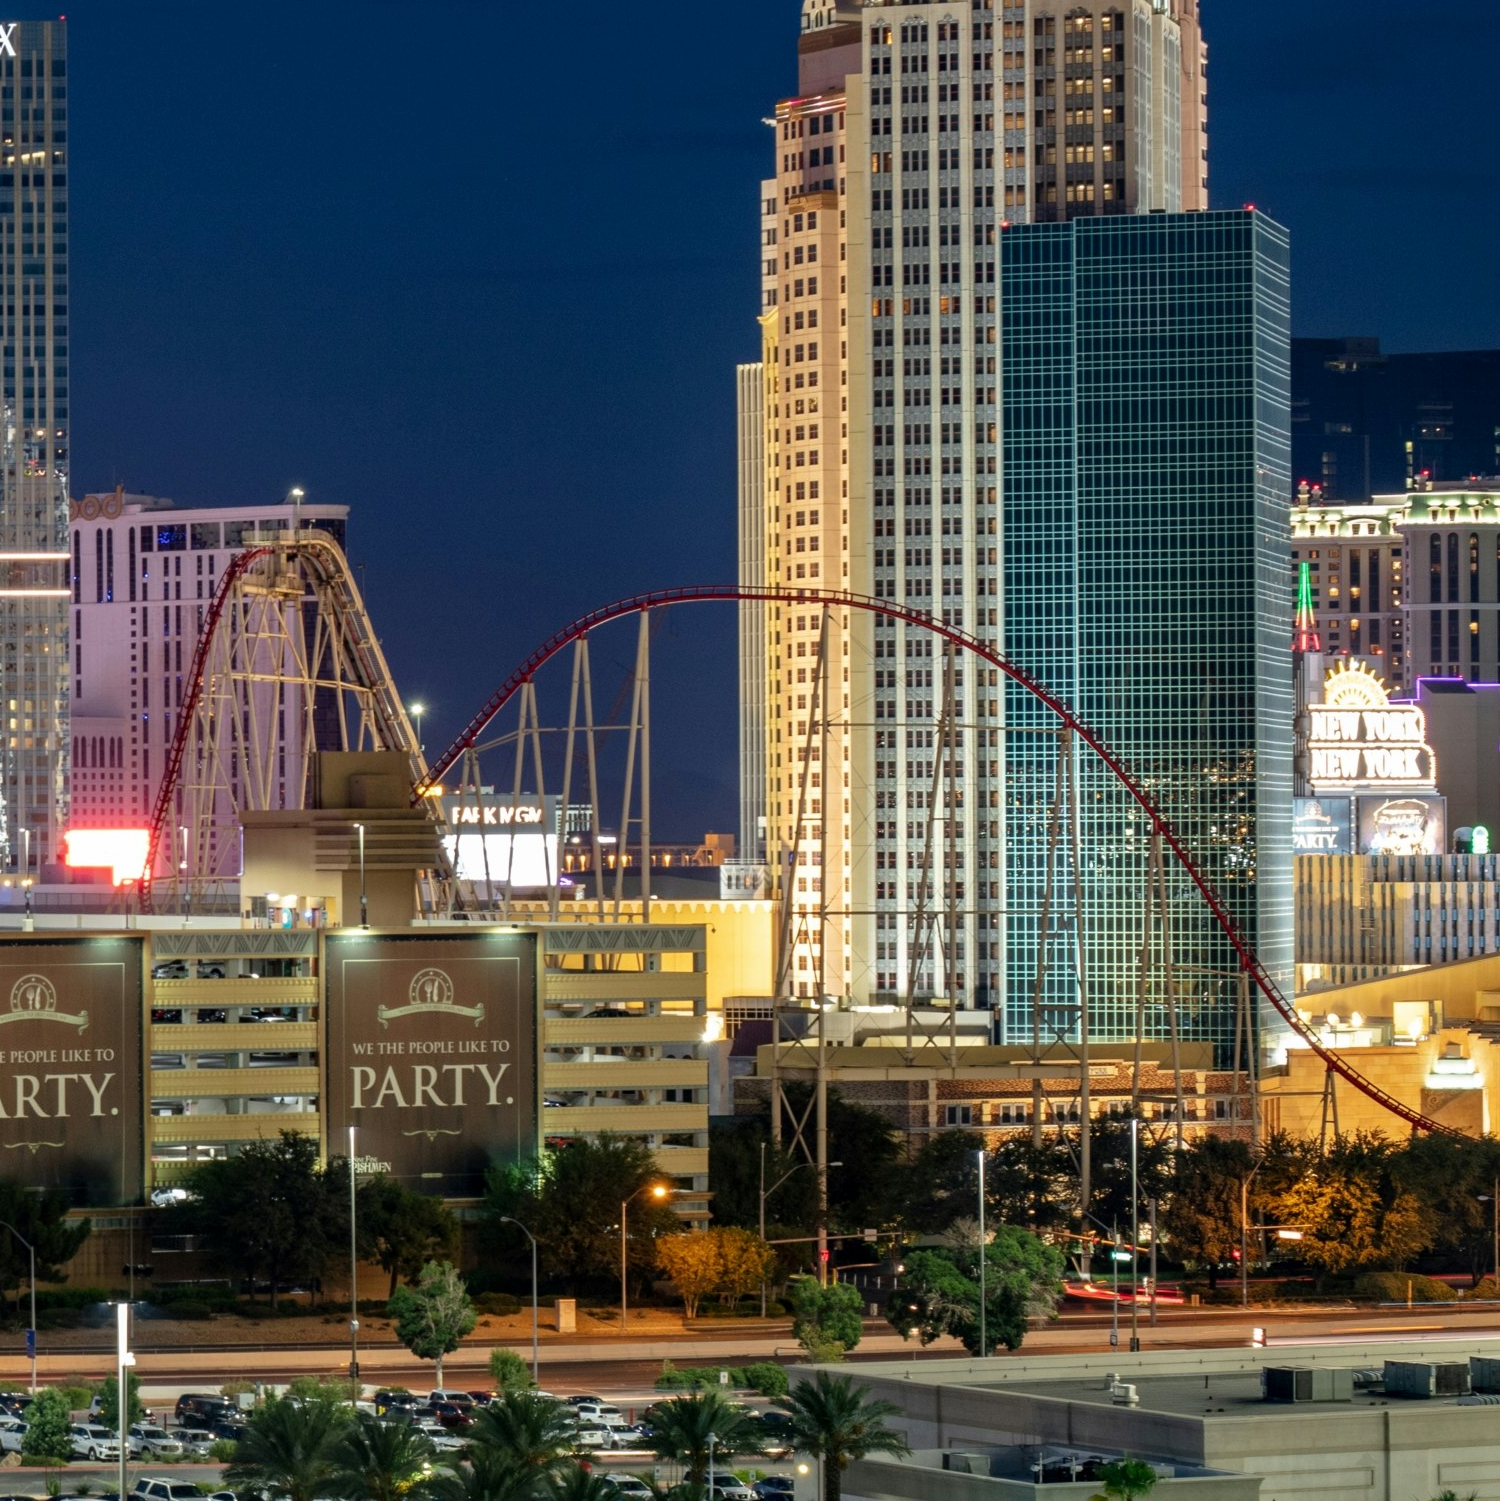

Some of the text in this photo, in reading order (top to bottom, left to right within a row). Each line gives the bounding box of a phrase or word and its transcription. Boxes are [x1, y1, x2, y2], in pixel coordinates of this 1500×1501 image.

[1311, 711, 1421, 740] NEW YORK
[1311, 749, 1421, 778] NEW YORK
[10, 1050, 57, 1063] PEOPLE
[62, 1049, 91, 1062] LIKE
[94, 1048, 115, 1061] TO
[353, 1040, 510, 1055] WE THE PEOPLE LIKE TO
[350, 1063, 514, 1109] PARTY.
